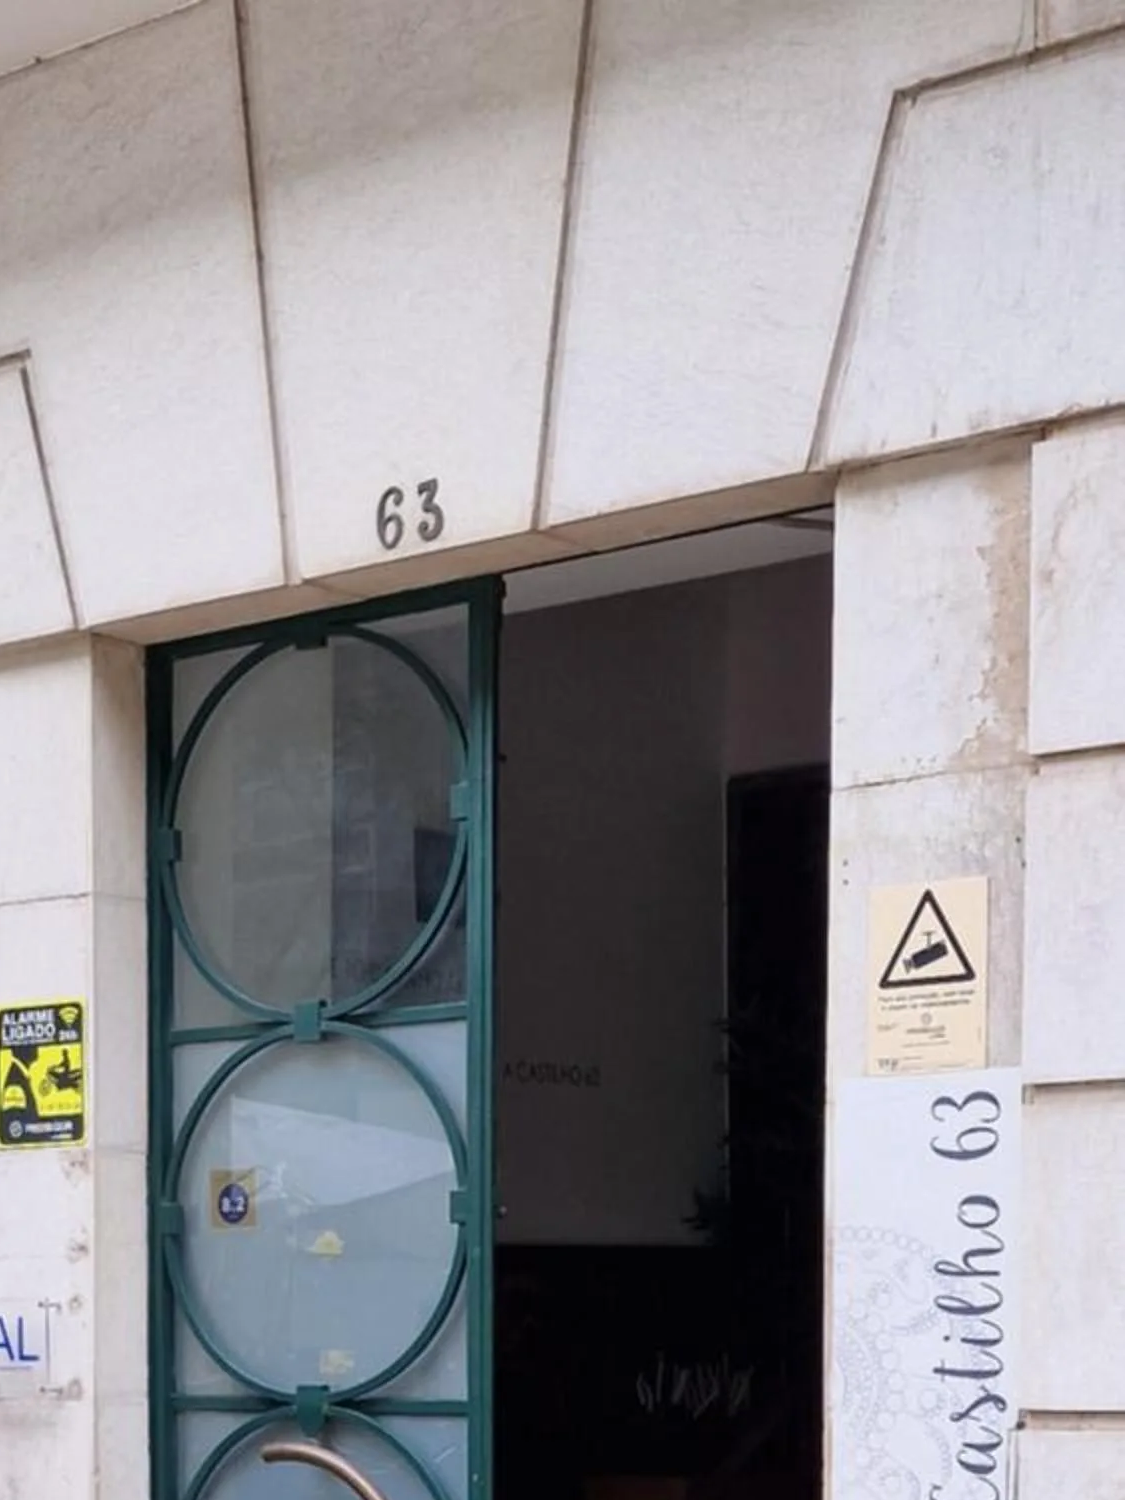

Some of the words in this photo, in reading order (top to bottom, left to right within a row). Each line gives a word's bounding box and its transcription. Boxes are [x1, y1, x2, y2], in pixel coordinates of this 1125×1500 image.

[376, 477, 444, 551] 63
[2, 1009, 54, 1024] ALARME
[2, 1023, 56, 1040] LIGADO
[930, 1091, 1002, 1161] 63
